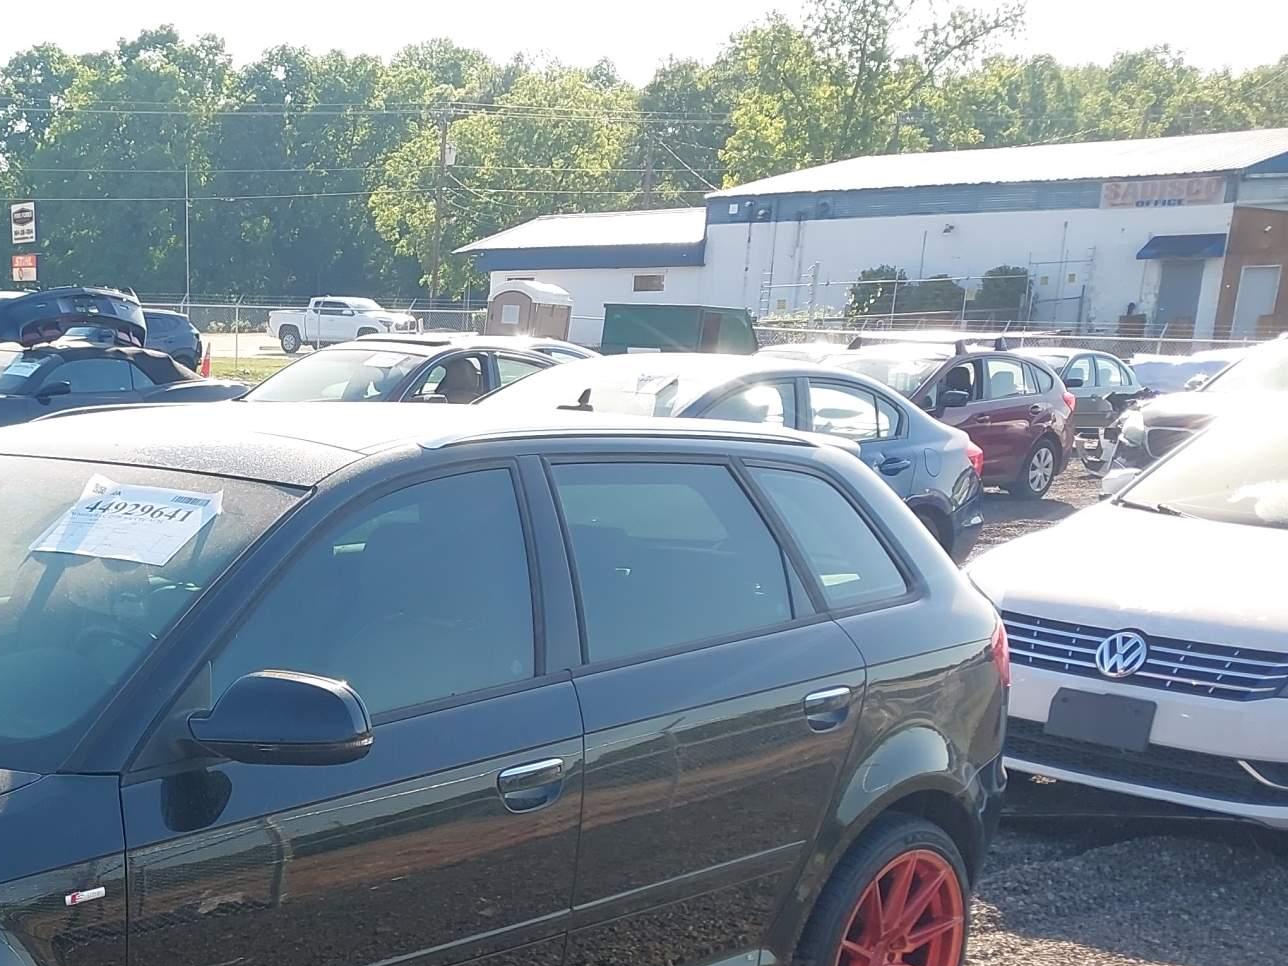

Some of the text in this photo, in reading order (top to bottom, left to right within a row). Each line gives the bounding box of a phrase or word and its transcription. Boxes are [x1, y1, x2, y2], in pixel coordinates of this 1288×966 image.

[1104, 178, 1223, 201] SADISCO
[1135, 198, 1185, 207] OFFICE
[85, 499, 193, 522] 44929641
